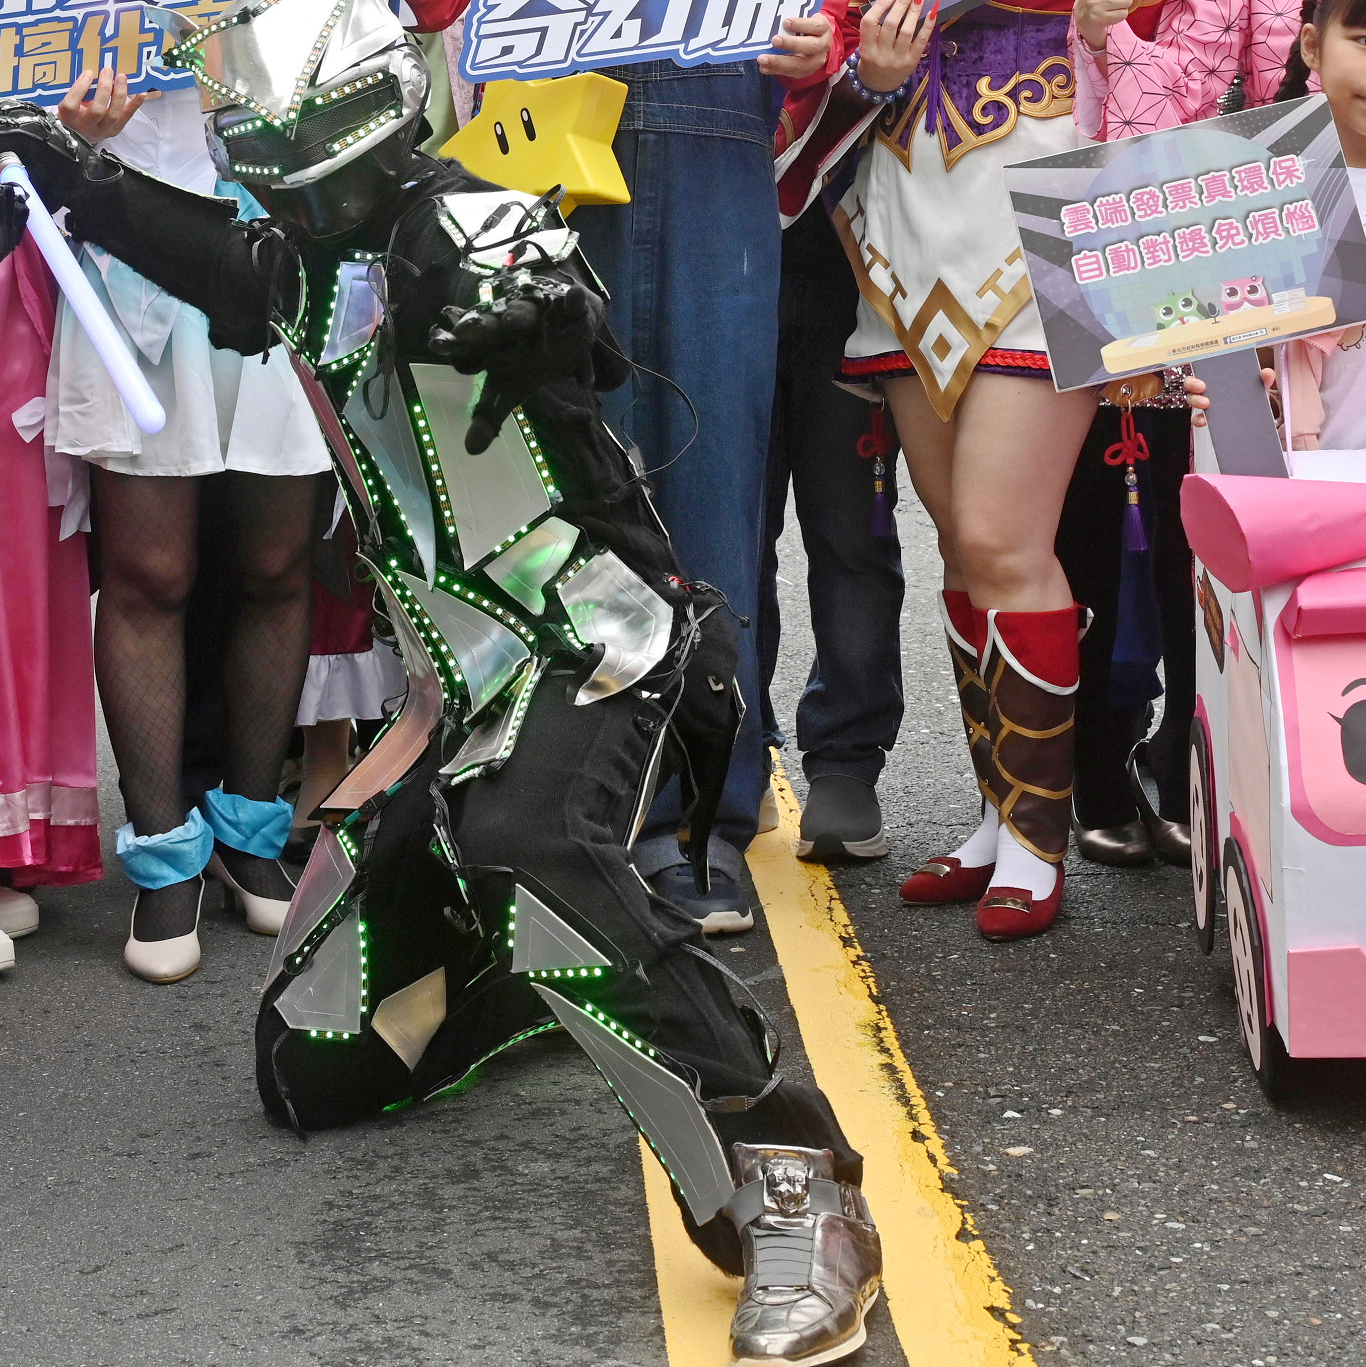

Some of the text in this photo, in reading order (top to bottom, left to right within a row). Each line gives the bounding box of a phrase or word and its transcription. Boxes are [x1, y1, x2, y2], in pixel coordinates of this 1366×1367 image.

[1060, 154, 1306, 237] 雲端發票真環保
[1070, 200, 1321, 285] 自動對獎免煩惱
